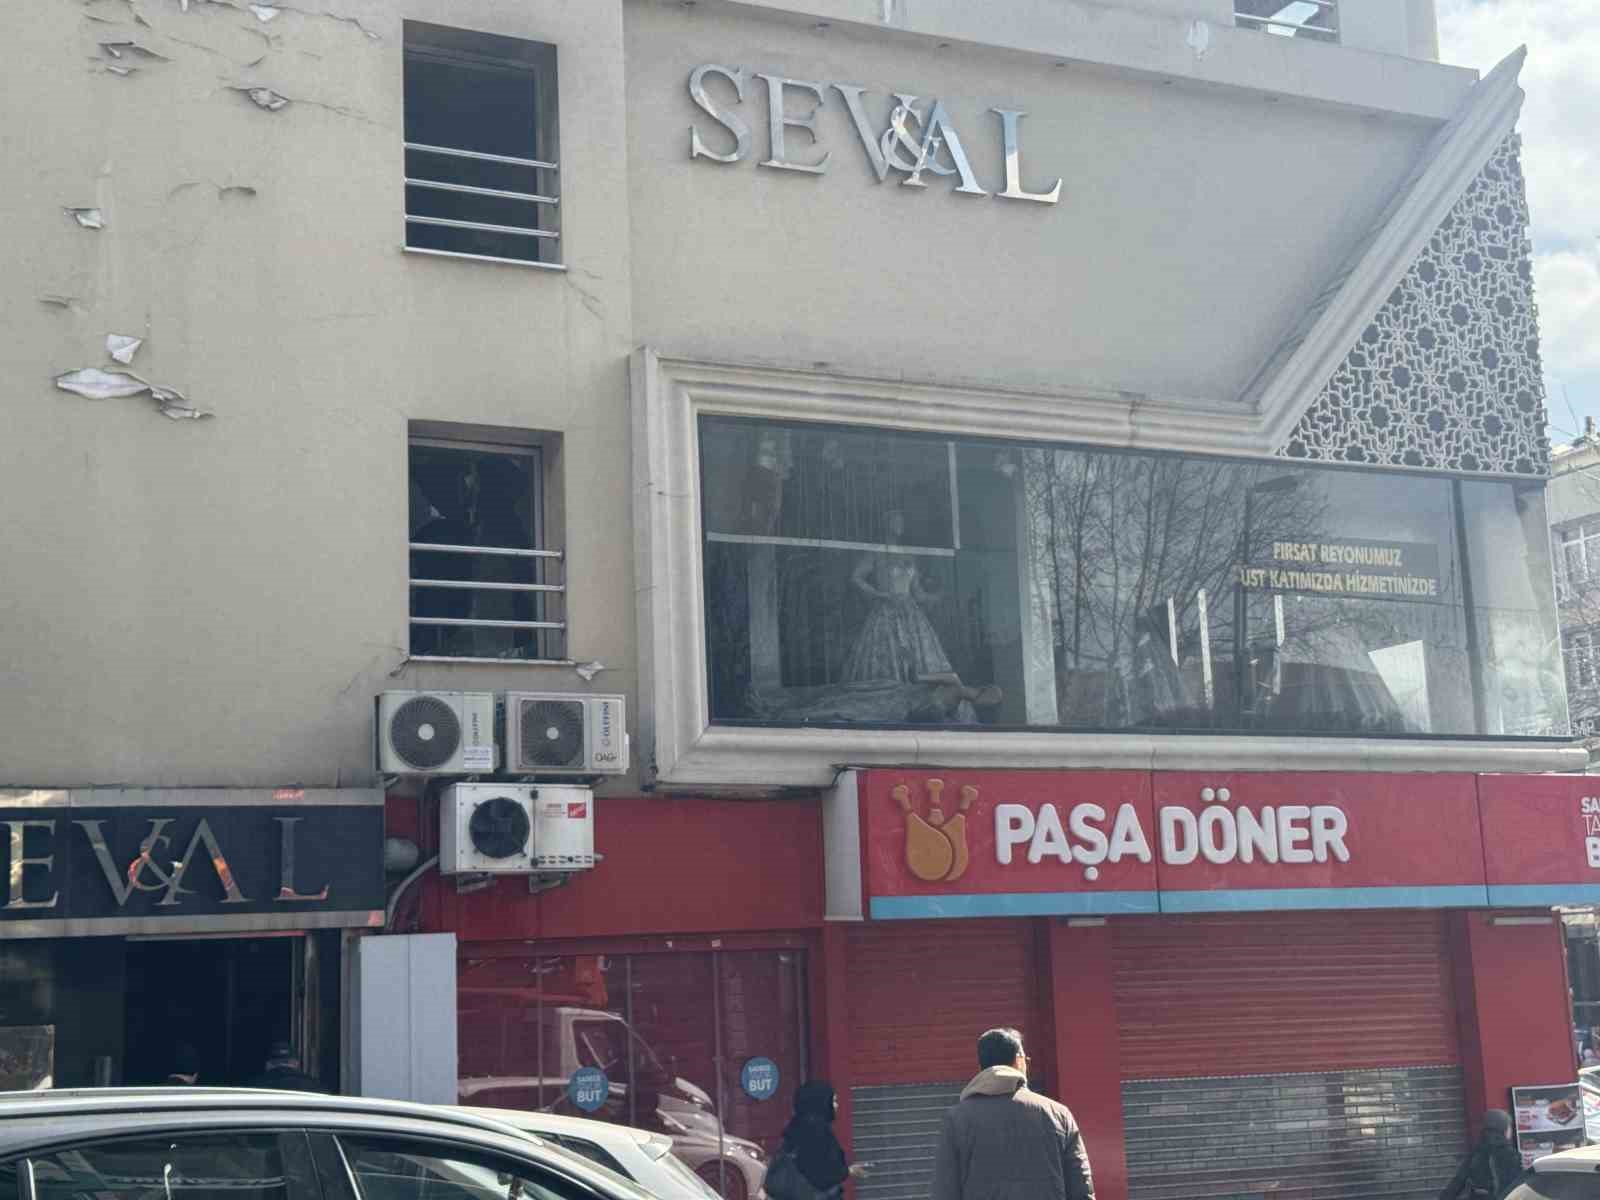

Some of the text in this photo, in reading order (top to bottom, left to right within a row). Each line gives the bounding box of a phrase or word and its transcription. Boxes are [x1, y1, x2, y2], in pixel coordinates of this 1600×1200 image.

[1273, 541, 1403, 567] FIRSAT REYONUMUZ
[1269, 569, 1344, 592] KATIMIZDA
[1345, 569, 1437, 596] HİZMETİNİZDE
[994, 786, 1351, 881] PAŞA DÖNER
[576, 1088, 602, 1103] BUT
[748, 1078, 773, 1092] BUT
